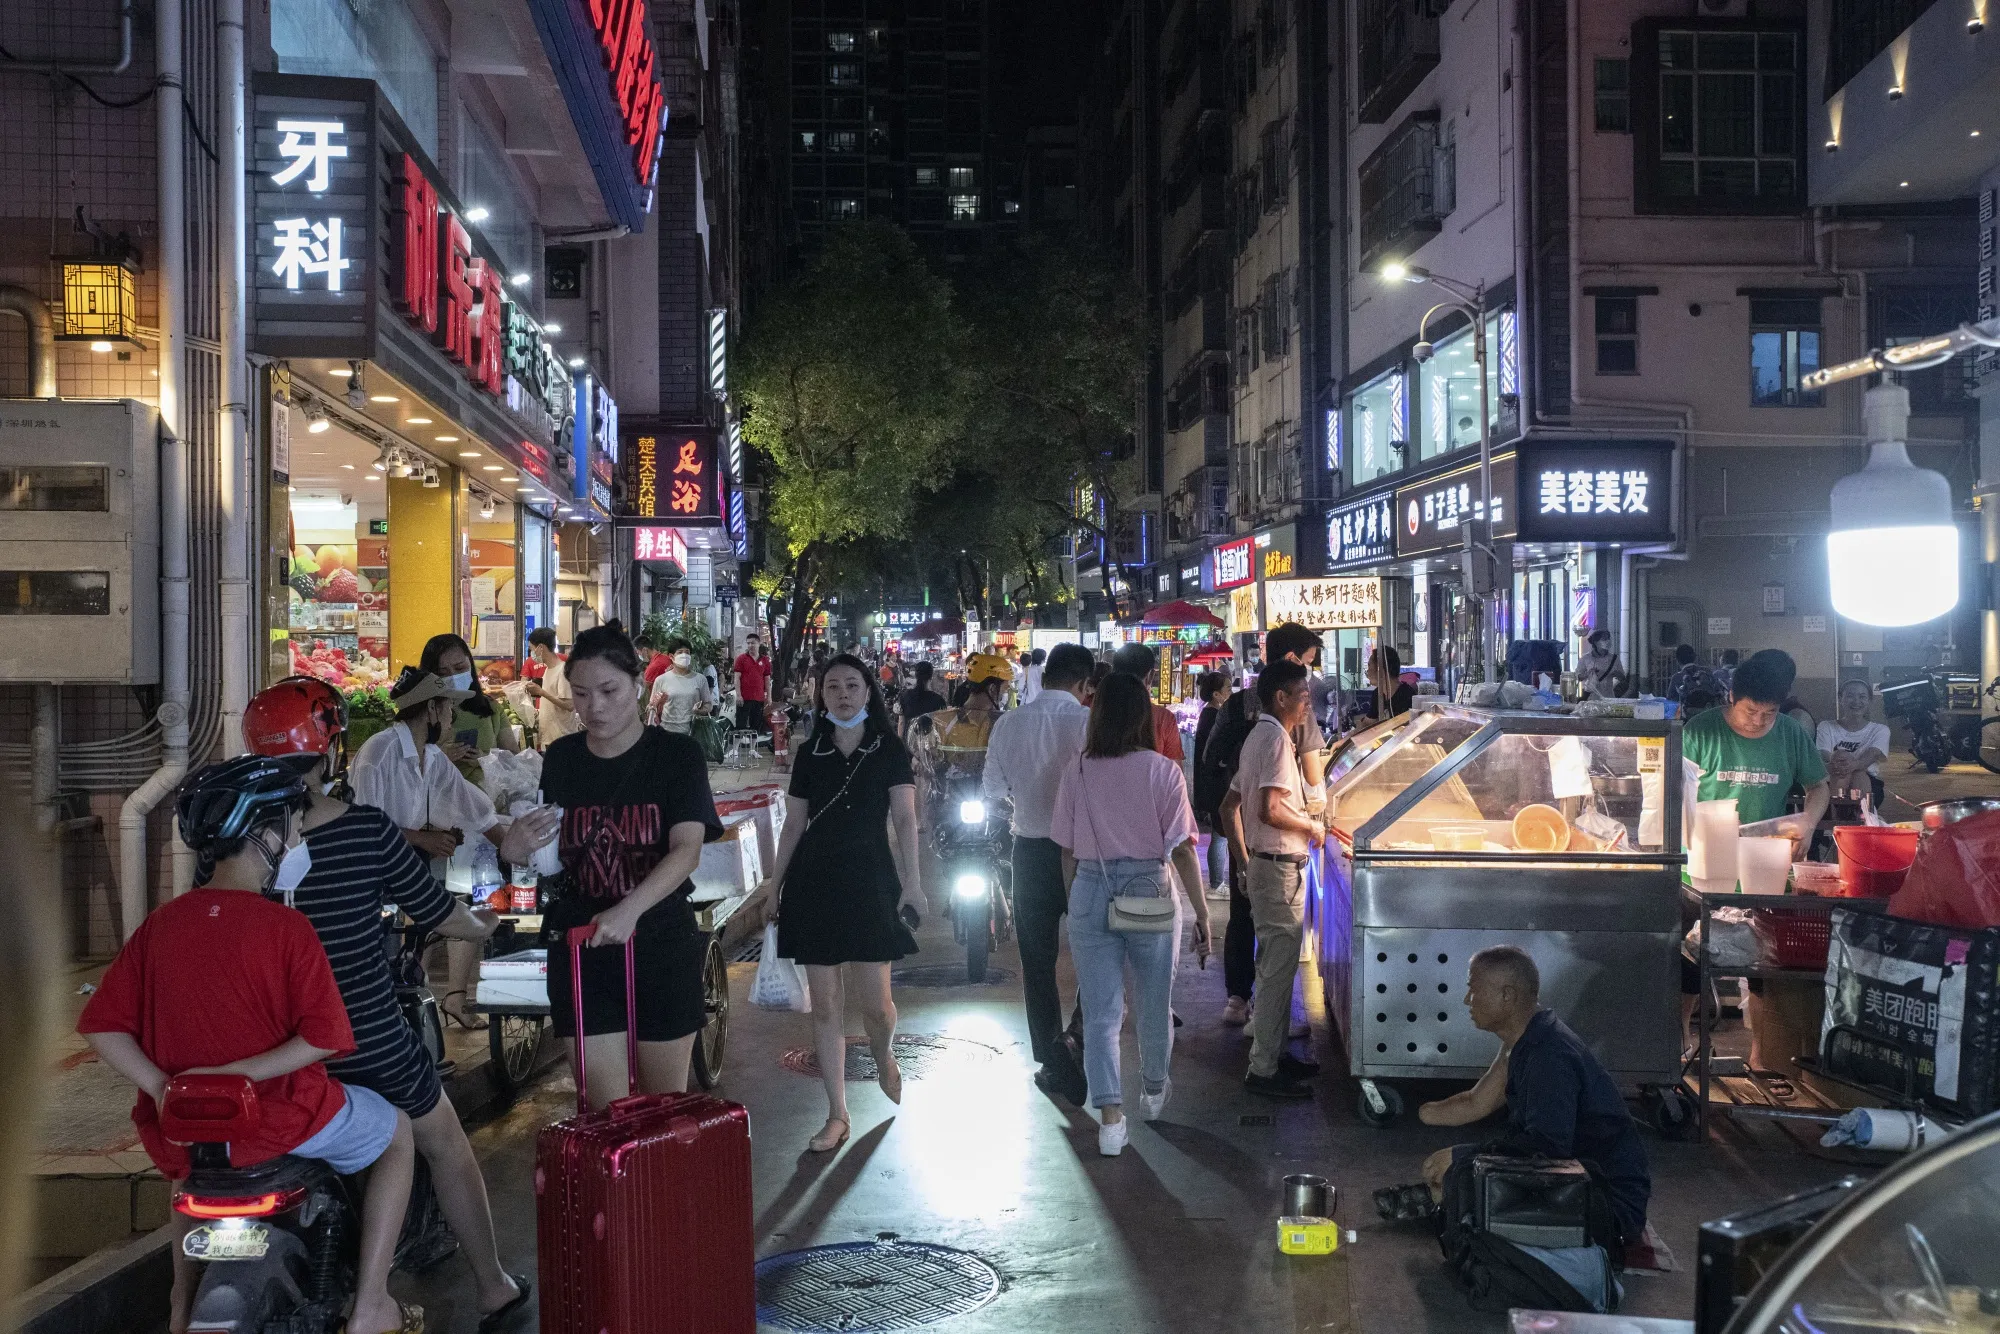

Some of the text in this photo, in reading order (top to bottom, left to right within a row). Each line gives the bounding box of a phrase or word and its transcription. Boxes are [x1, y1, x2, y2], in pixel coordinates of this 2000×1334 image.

[271, 119, 350, 292] 牙科
[638, 436, 657, 517] 楚天宾馆
[671, 440, 703, 514] 足浴
[1539, 469, 1650, 515] 美容美发
[638, 528, 672, 560] 养生
[1838, 740, 1861, 752] NIKE
[1864, 1019, 1935, 1045] 一小时 全城
